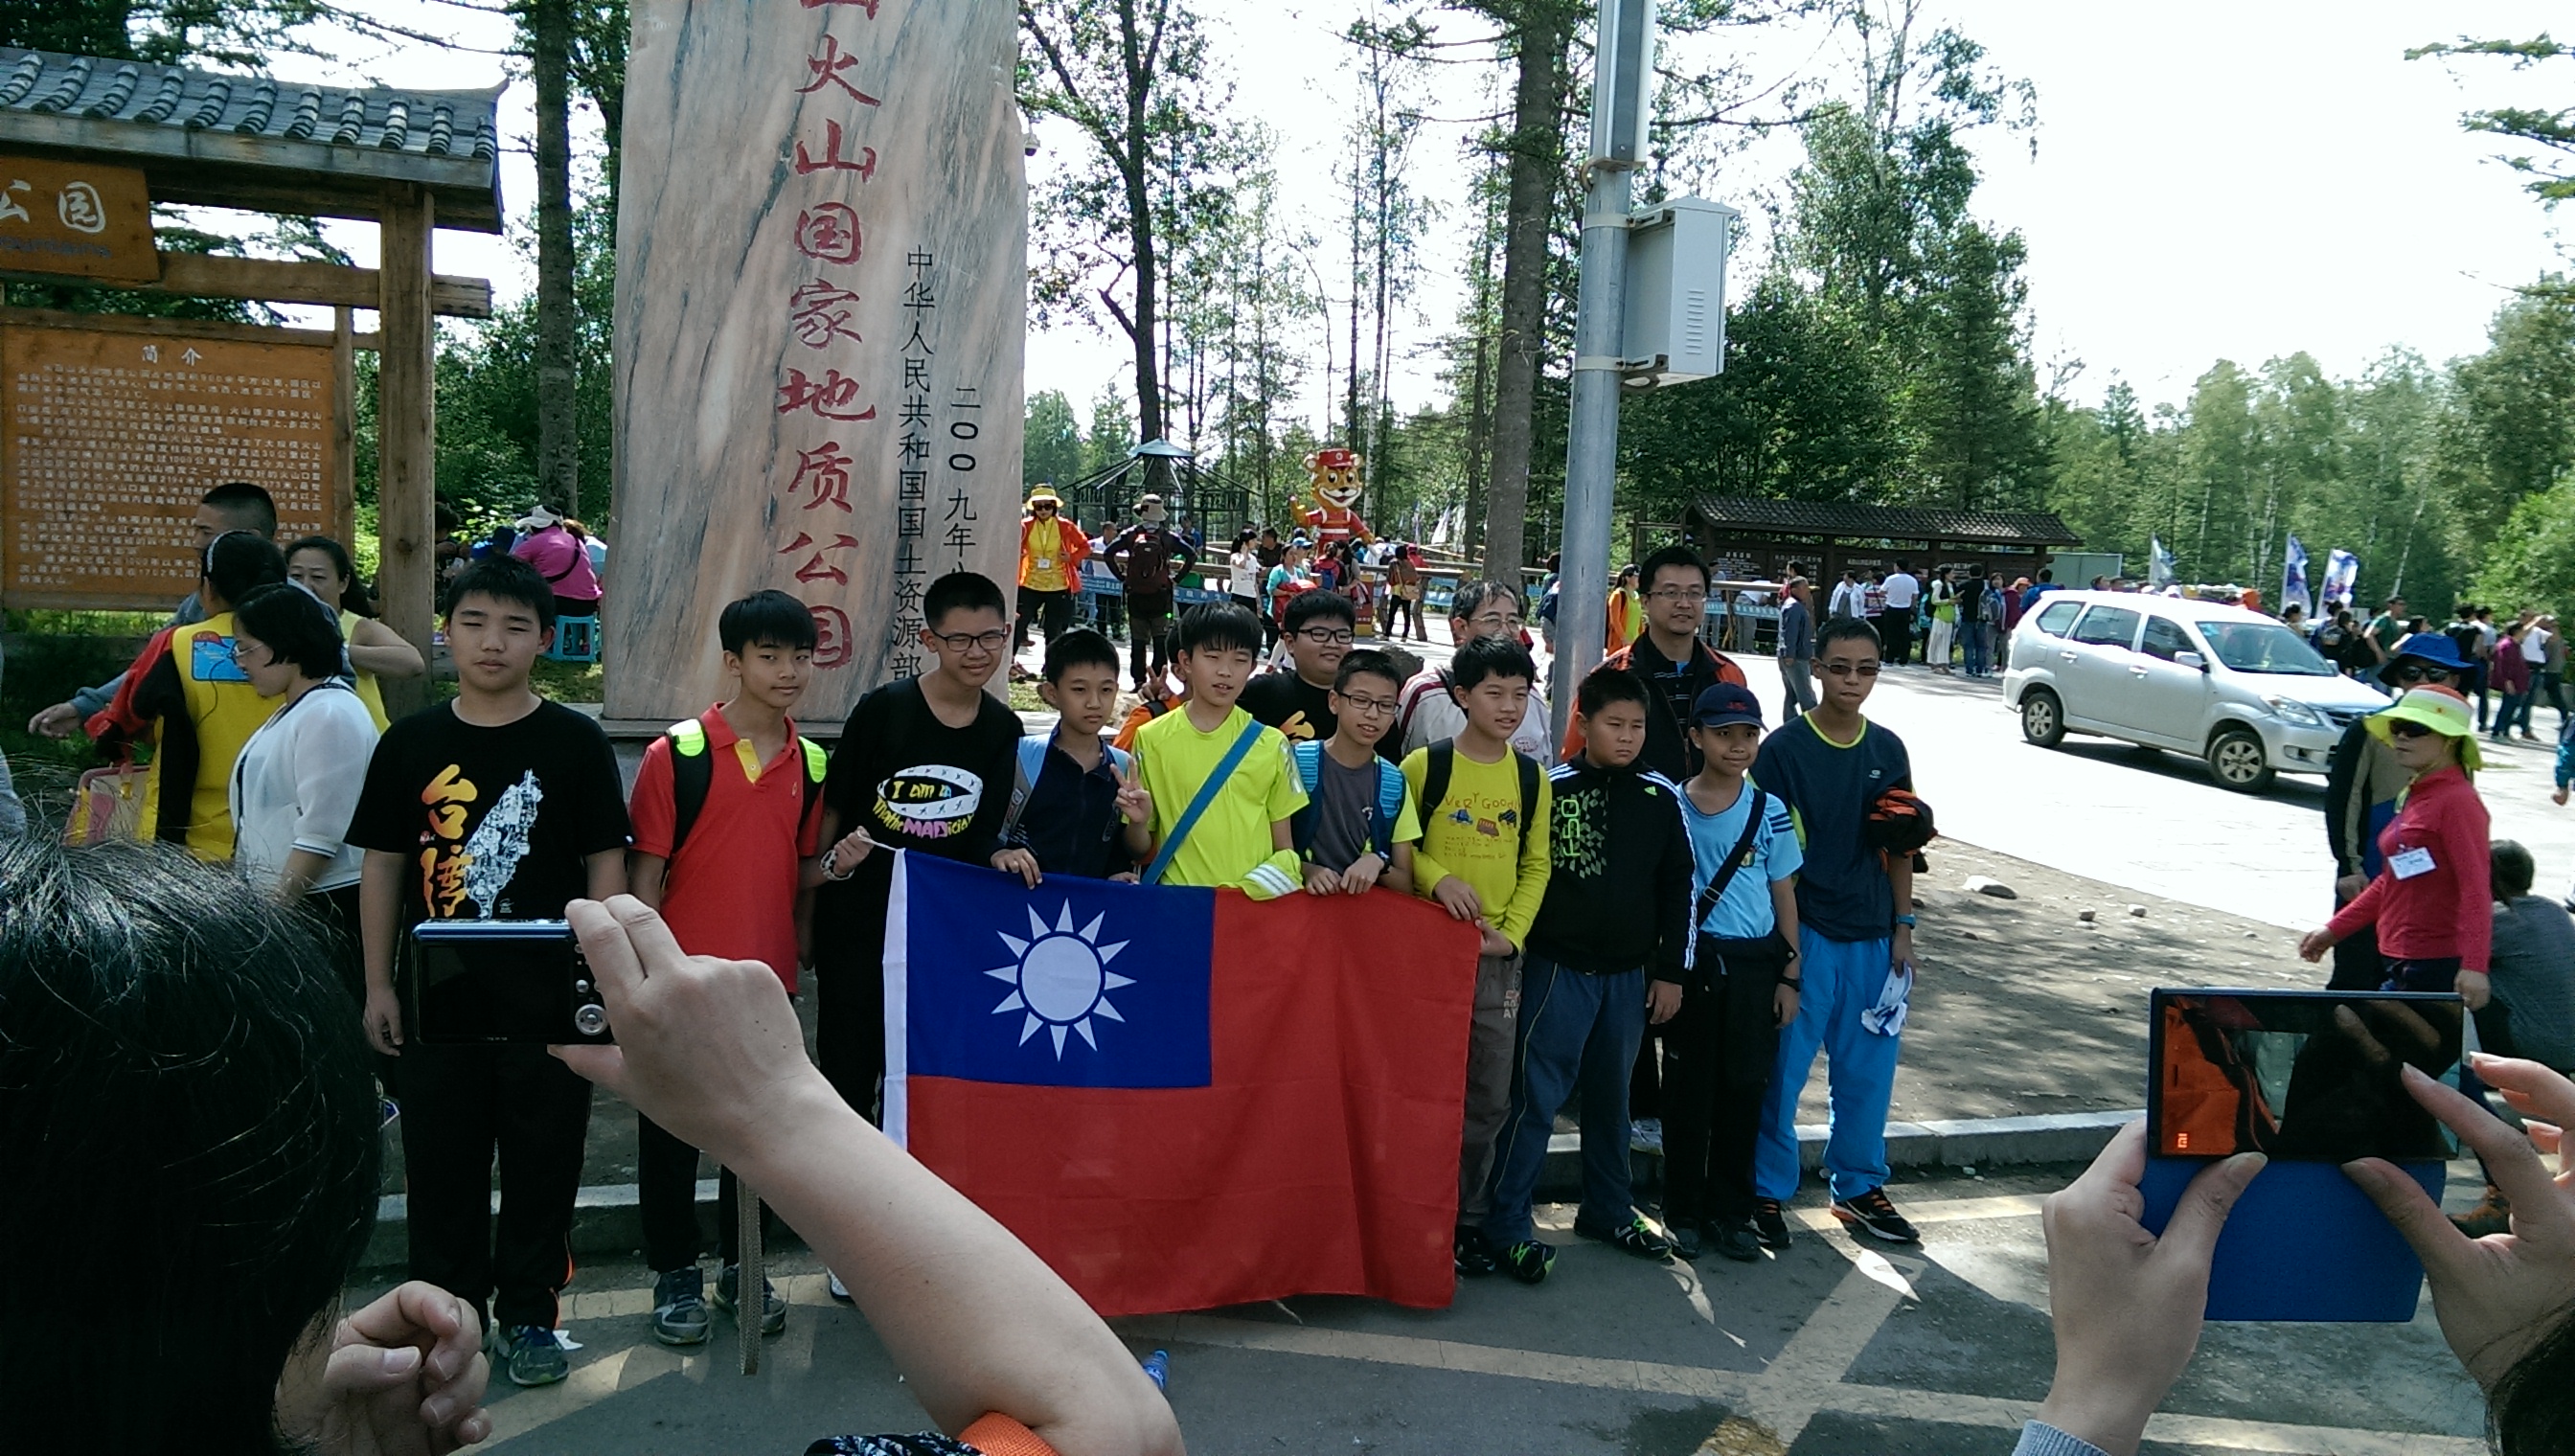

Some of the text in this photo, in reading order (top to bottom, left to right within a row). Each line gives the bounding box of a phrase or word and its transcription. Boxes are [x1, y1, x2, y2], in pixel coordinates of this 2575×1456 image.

[890, 244, 936, 680] 中华人民共和国国土资源部
[892, 781, 905, 800] I
